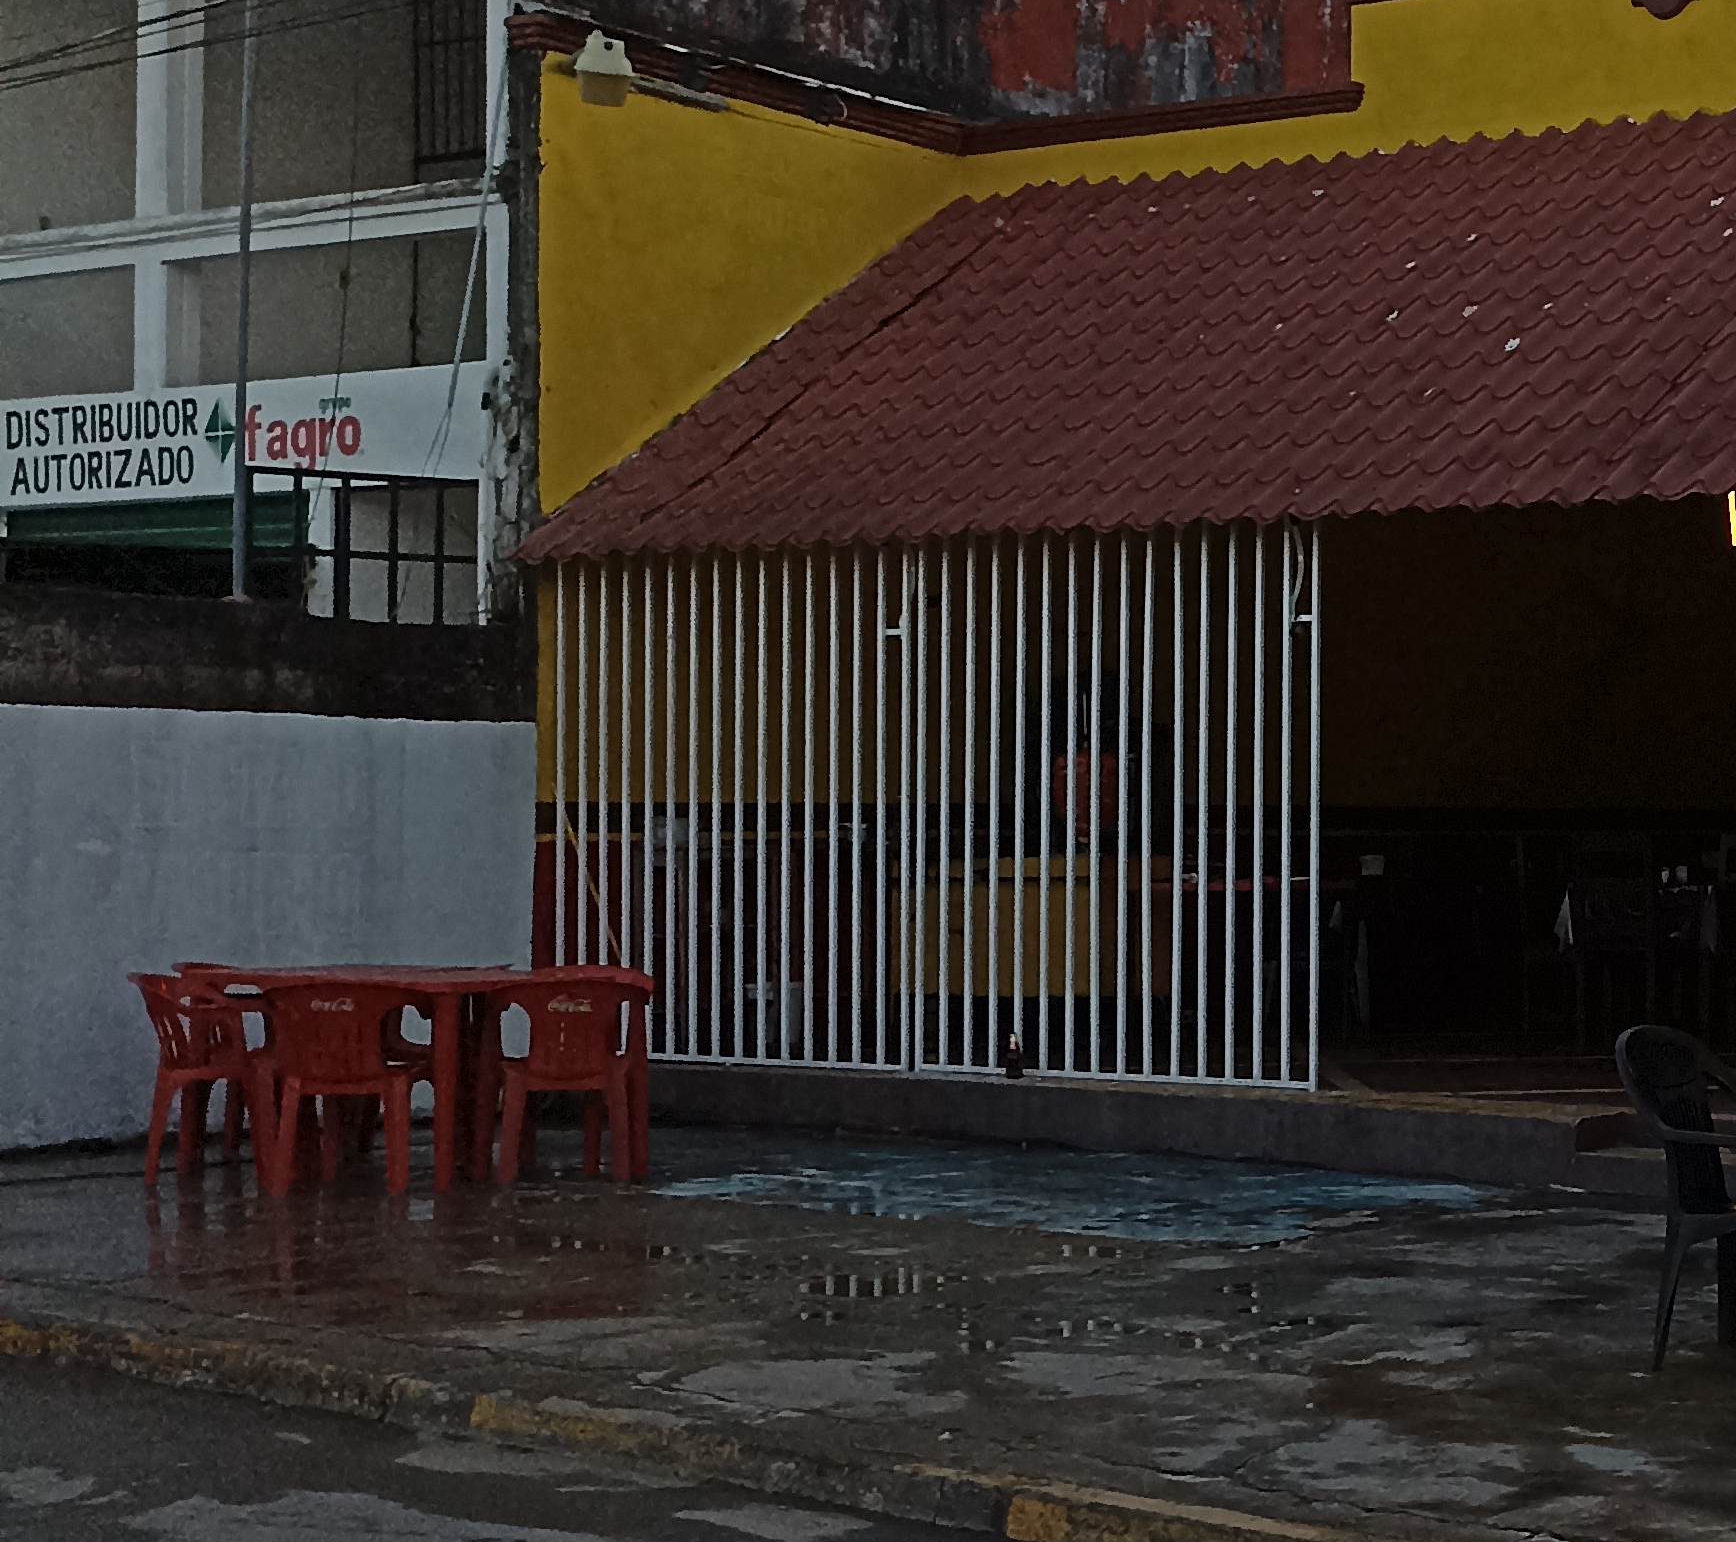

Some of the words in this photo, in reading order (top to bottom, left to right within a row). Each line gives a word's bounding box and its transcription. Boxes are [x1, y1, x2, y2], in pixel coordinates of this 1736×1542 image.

[6, 398, 198, 449] DISTRIBUIDOR
[244, 404, 362, 472] fagro
[10, 445, 194, 495] AUTORIZADO
